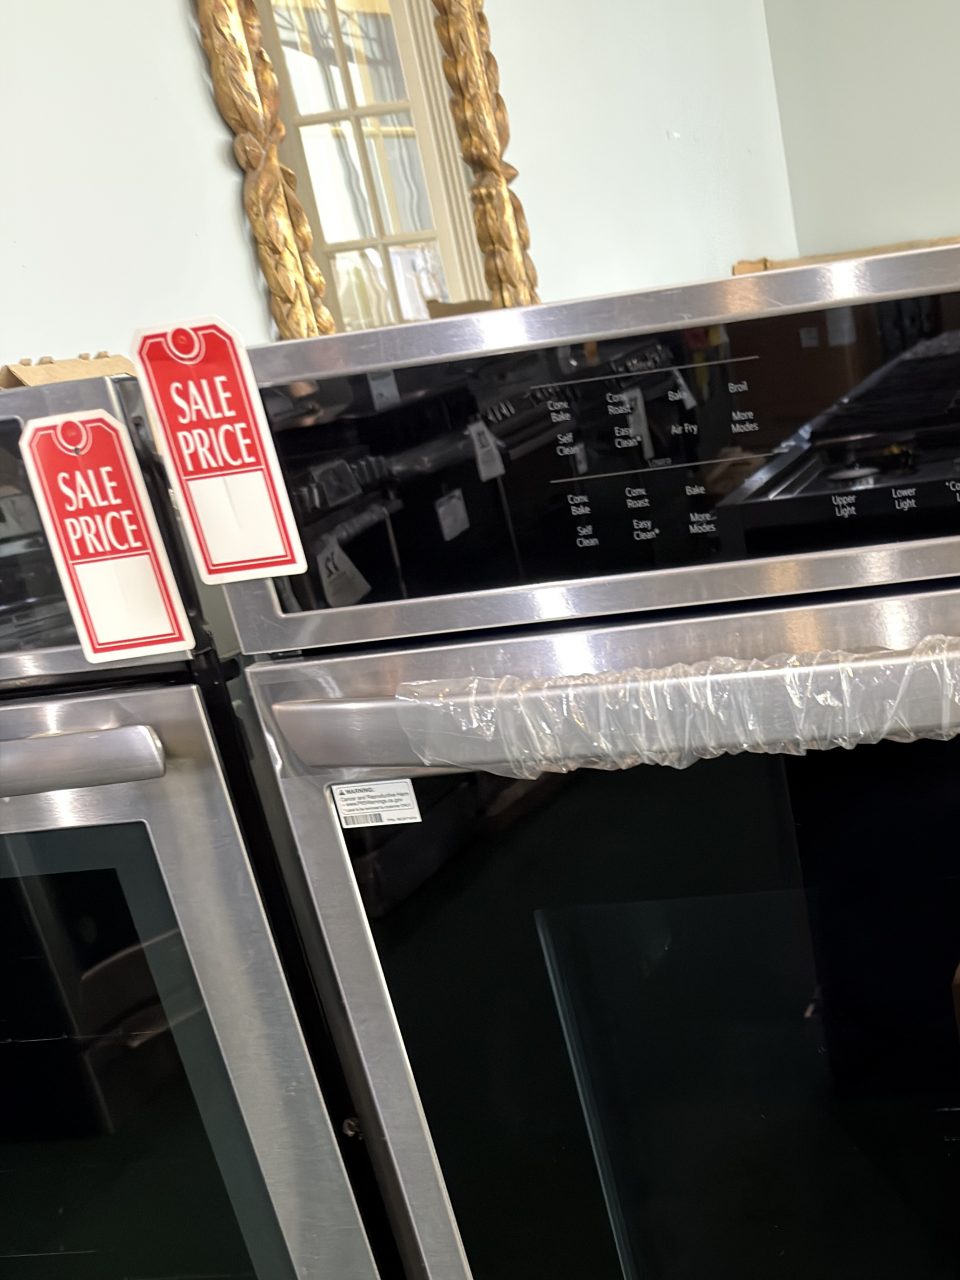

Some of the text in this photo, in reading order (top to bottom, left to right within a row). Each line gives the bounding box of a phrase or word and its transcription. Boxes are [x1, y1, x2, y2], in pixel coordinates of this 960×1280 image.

[728, 381, 748, 394] Broil
[170, 376, 236, 424] SALE
[668, 390, 688, 401] Bake
[608, 404, 632, 415] Roast
[551, 412, 572, 422] Bake
[732, 410, 754, 421] More
[614, 426, 633, 438] Easy
[670, 424, 698, 436] Air Fry
[731, 422, 759, 434] Modes
[557, 433, 574, 444] Self
[177, 422, 256, 472] PRICE
[58, 466, 122, 512] SALE
[686, 486, 706, 496] Bake
[892, 487, 916, 498] Lower
[626, 498, 650, 508] Roast
[832, 494, 856, 506] Upper
[895, 498, 916, 511] Light
[571, 506, 591, 516] Bake
[835, 506, 857, 518] Light
[577, 526, 593, 536] Self
[633, 520, 652, 531] Easy
[688, 523, 716, 534] Modes
[64, 510, 142, 556] PRICE
[576, 536, 599, 548] Clean
